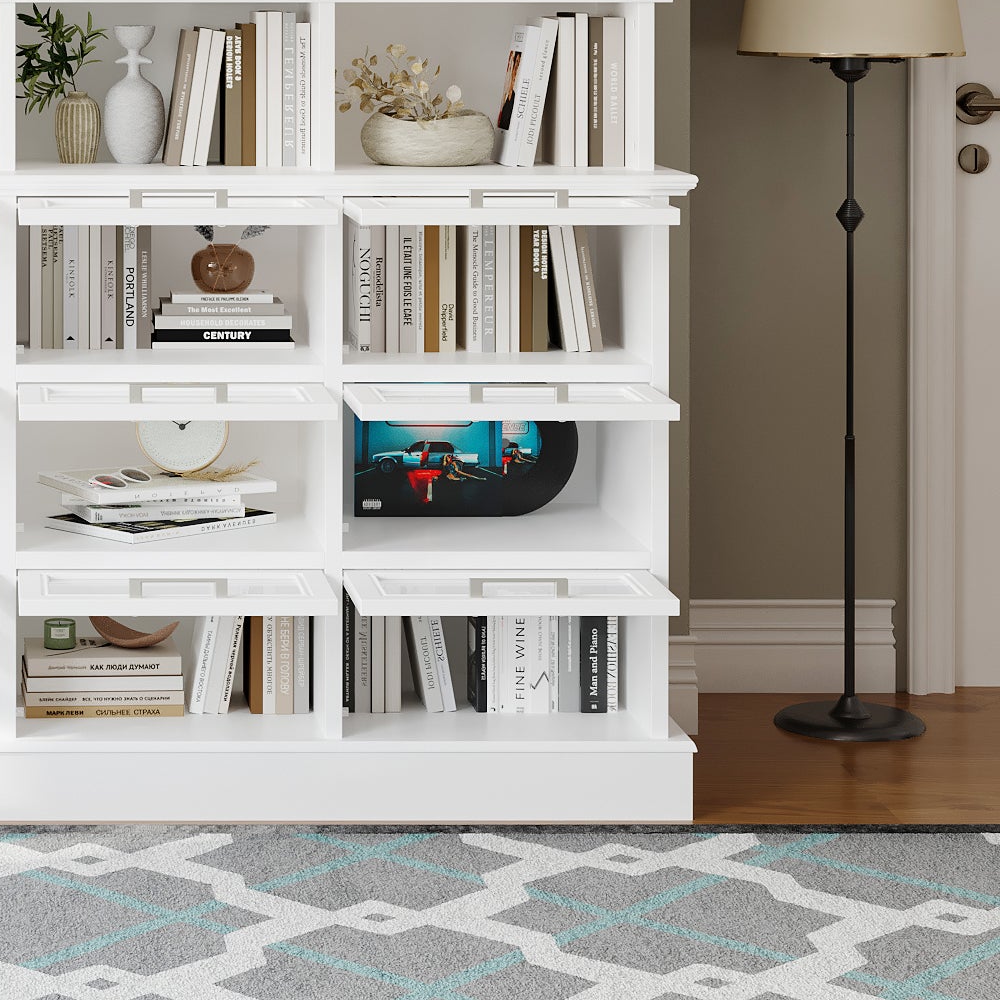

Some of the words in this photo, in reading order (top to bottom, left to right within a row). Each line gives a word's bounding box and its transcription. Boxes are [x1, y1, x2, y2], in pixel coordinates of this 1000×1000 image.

[518, 78, 530, 118] SCHIELE
[126, 267, 134, 326] PORTLAND
[360, 248, 370, 322] NOGUCHI
[203, 331, 252, 340] CENTURY
[516, 618, 524, 659] WINE
[106, 664, 128, 672] ЛЮДИ
[129, 663, 160, 671] ДУМАЮТ
[516, 666, 524, 700] FINE
